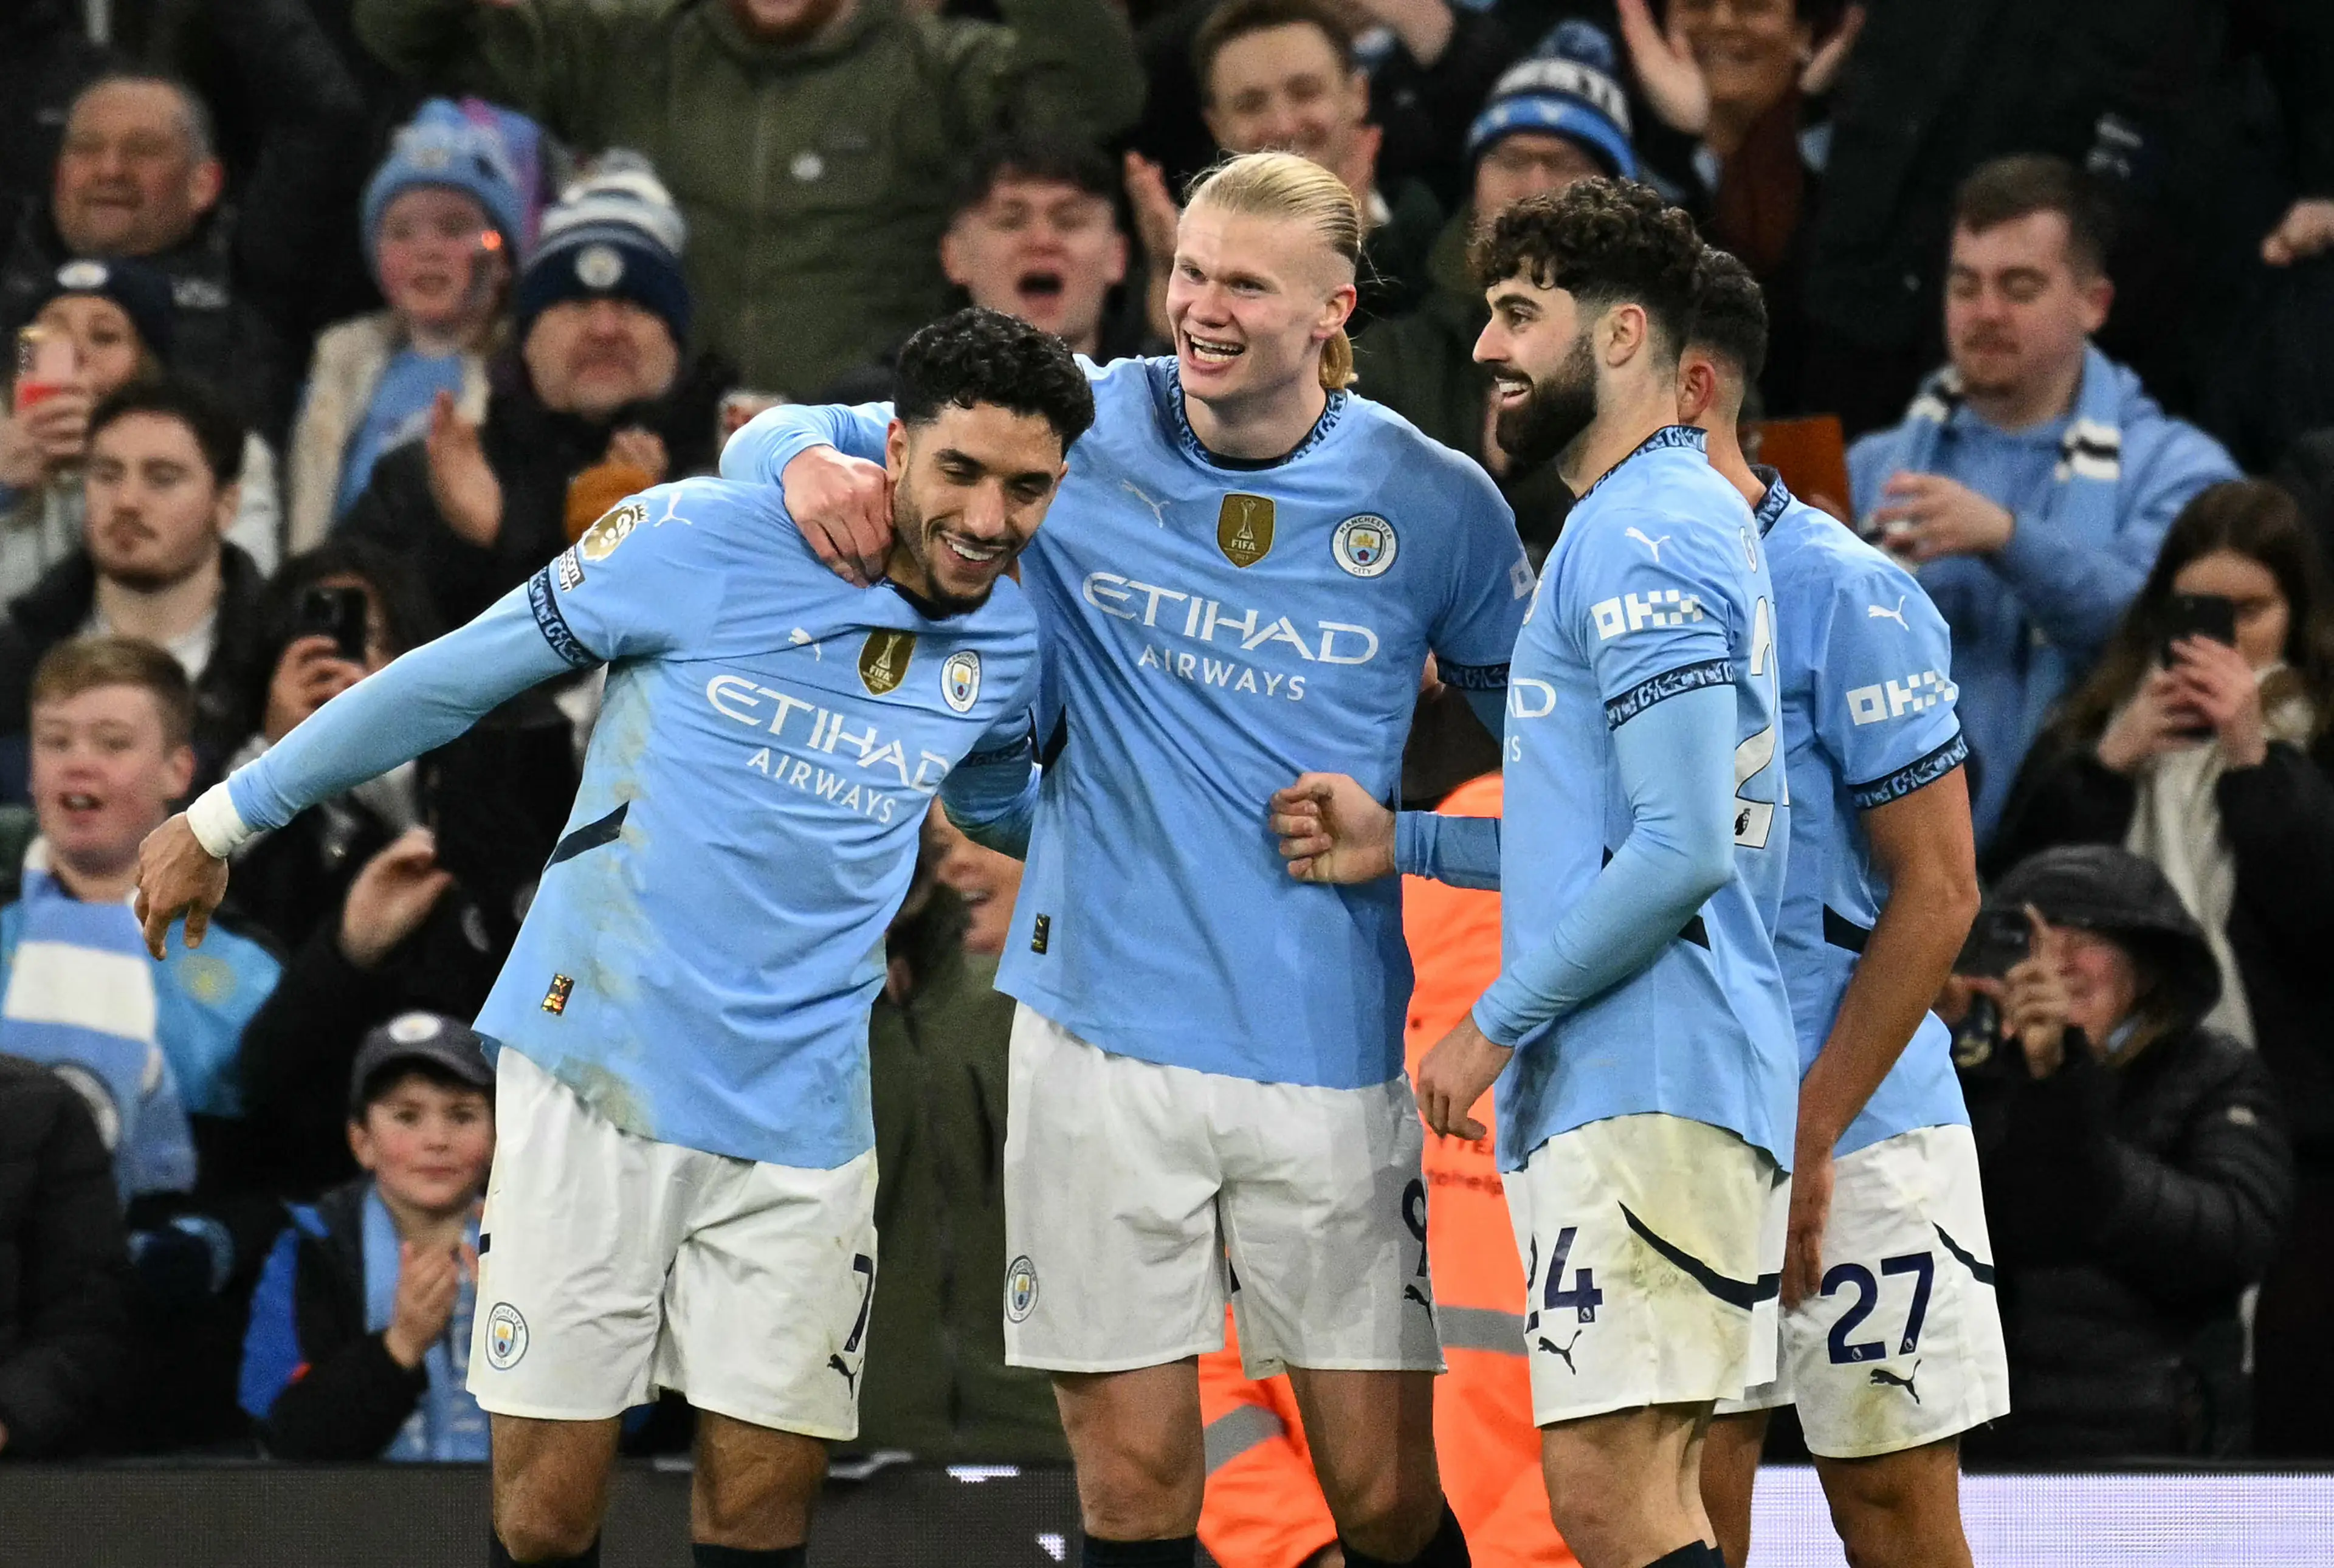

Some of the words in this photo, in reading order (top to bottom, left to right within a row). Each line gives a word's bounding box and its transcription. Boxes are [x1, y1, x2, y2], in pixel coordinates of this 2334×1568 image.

[1231, 538, 1255, 551] FIFA
[1339, 517, 1392, 540] MANCHESTER
[1083, 571, 1379, 665] ETIHAD
[869, 665, 890, 681] FIFA
[1138, 644, 1306, 701] AIRWAYS
[706, 675, 949, 794] ETIHAD
[746, 748, 897, 824] AIRWAYS
[843, 1253, 873, 1354] 7
[1820, 1251, 1935, 1364] 27
